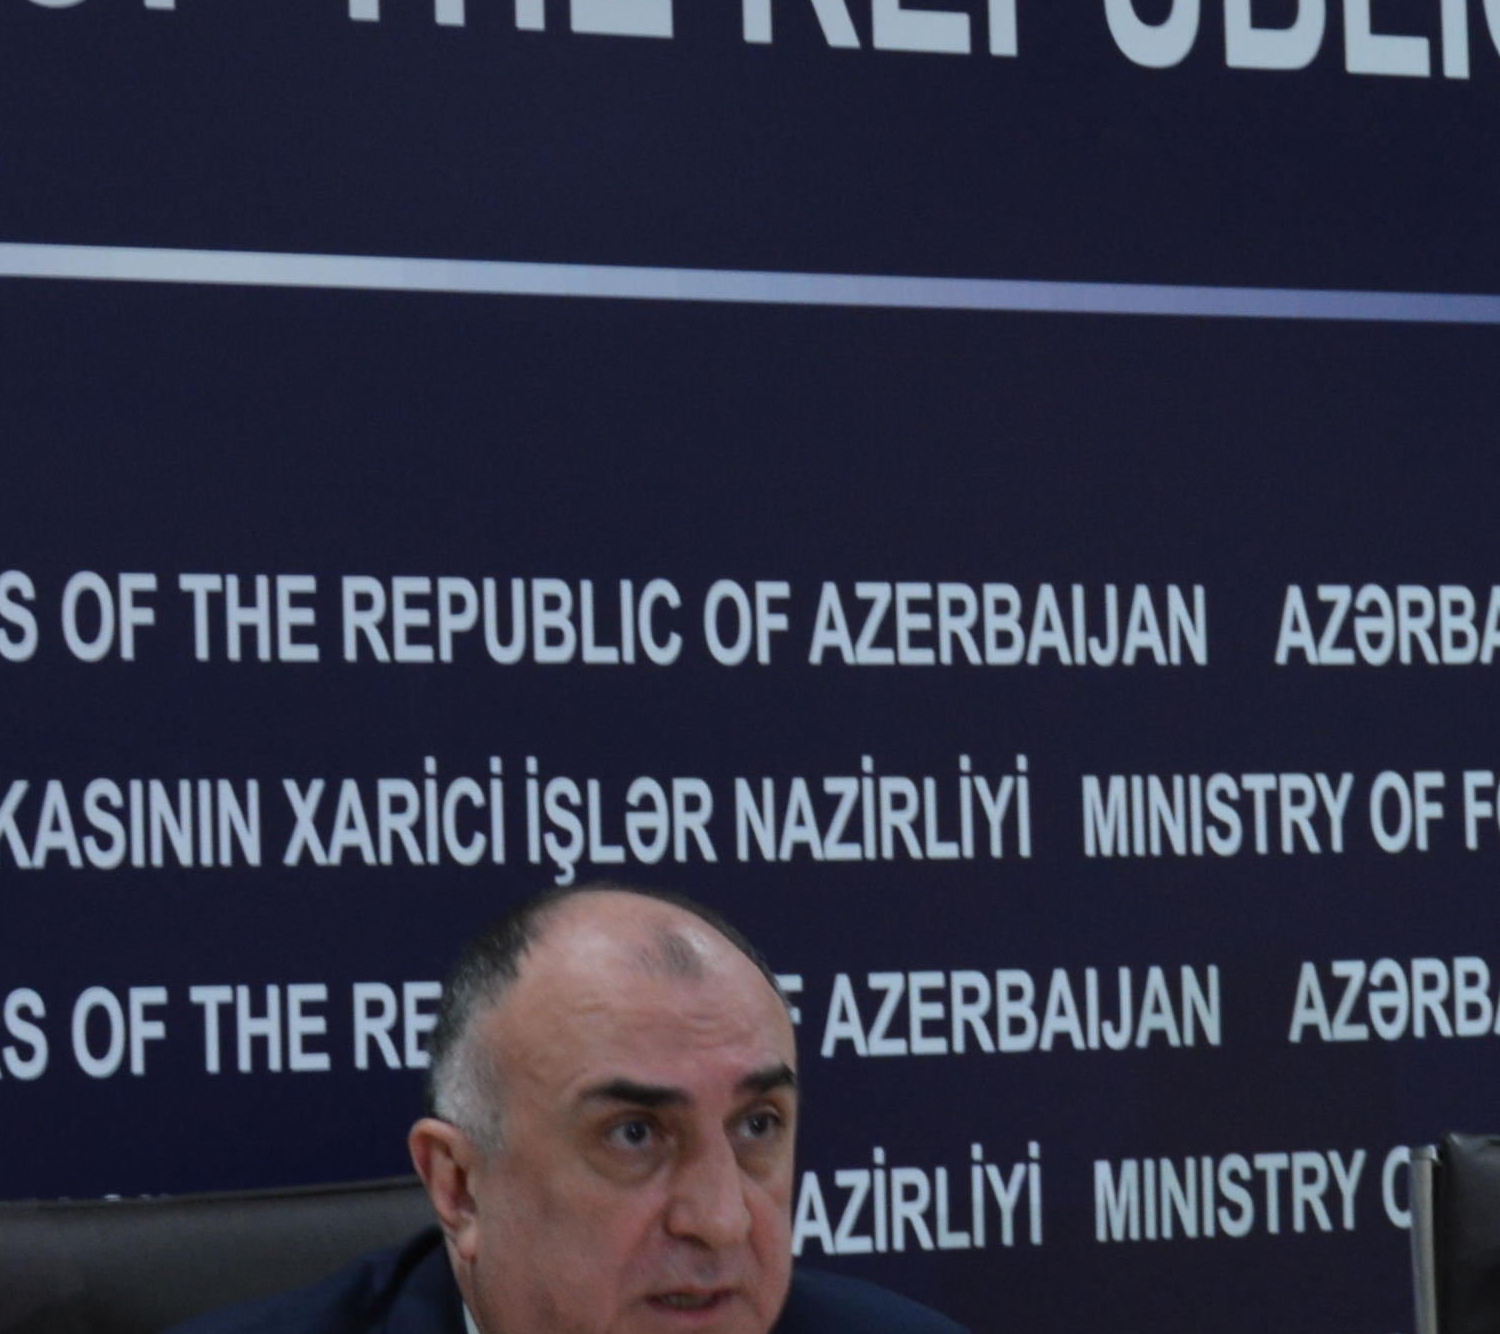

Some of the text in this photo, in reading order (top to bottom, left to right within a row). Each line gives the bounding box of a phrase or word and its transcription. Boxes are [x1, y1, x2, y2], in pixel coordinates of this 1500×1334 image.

[61, 570, 158, 663] OF
[178, 573, 320, 662] THE
[341, 575, 683, 666] REPUBLIC
[703, 579, 791, 666] OF
[808, 581, 1208, 667] AZERBAIJAN
[282, 755, 506, 867] XARİCİ
[523, 755, 718, 884] İŞLƏR
[734, 754, 1031, 862] NAZİRLİYİ
[1082, 772, 1355, 858] MINISTRY
[1369, 770, 1445, 854] OF
[71, 986, 168, 1079] OF
[189, 983, 331, 1074] THE
[820, 964, 1221, 1058] AZERBAIJAN
[1094, 1148, 1367, 1243] MINISTRY
